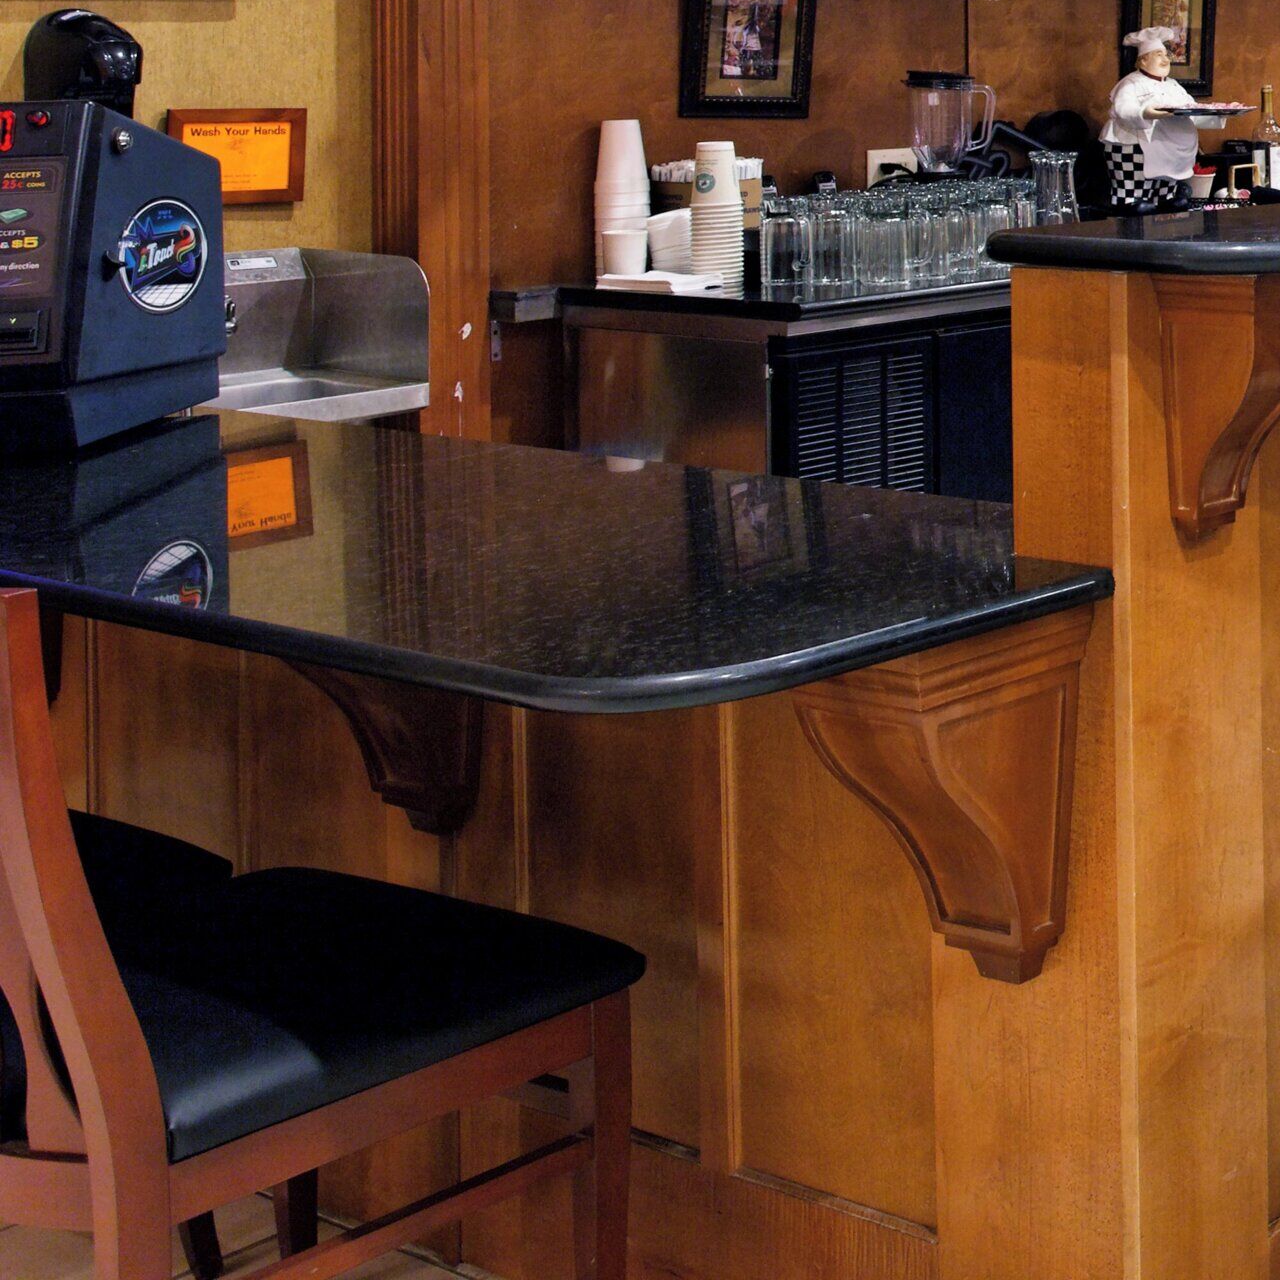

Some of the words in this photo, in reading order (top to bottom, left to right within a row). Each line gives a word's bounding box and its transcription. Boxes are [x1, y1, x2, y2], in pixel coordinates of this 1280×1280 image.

[191, 127, 220, 136] Wash
[225, 127, 250, 135] Your
[254, 125, 286, 135] Hands
[4, 171, 41, 179] ACCEPTS
[2, 180, 23, 189] 25¢
[12, 236, 39, 249] $5
[9, 262, 40, 271] direction
